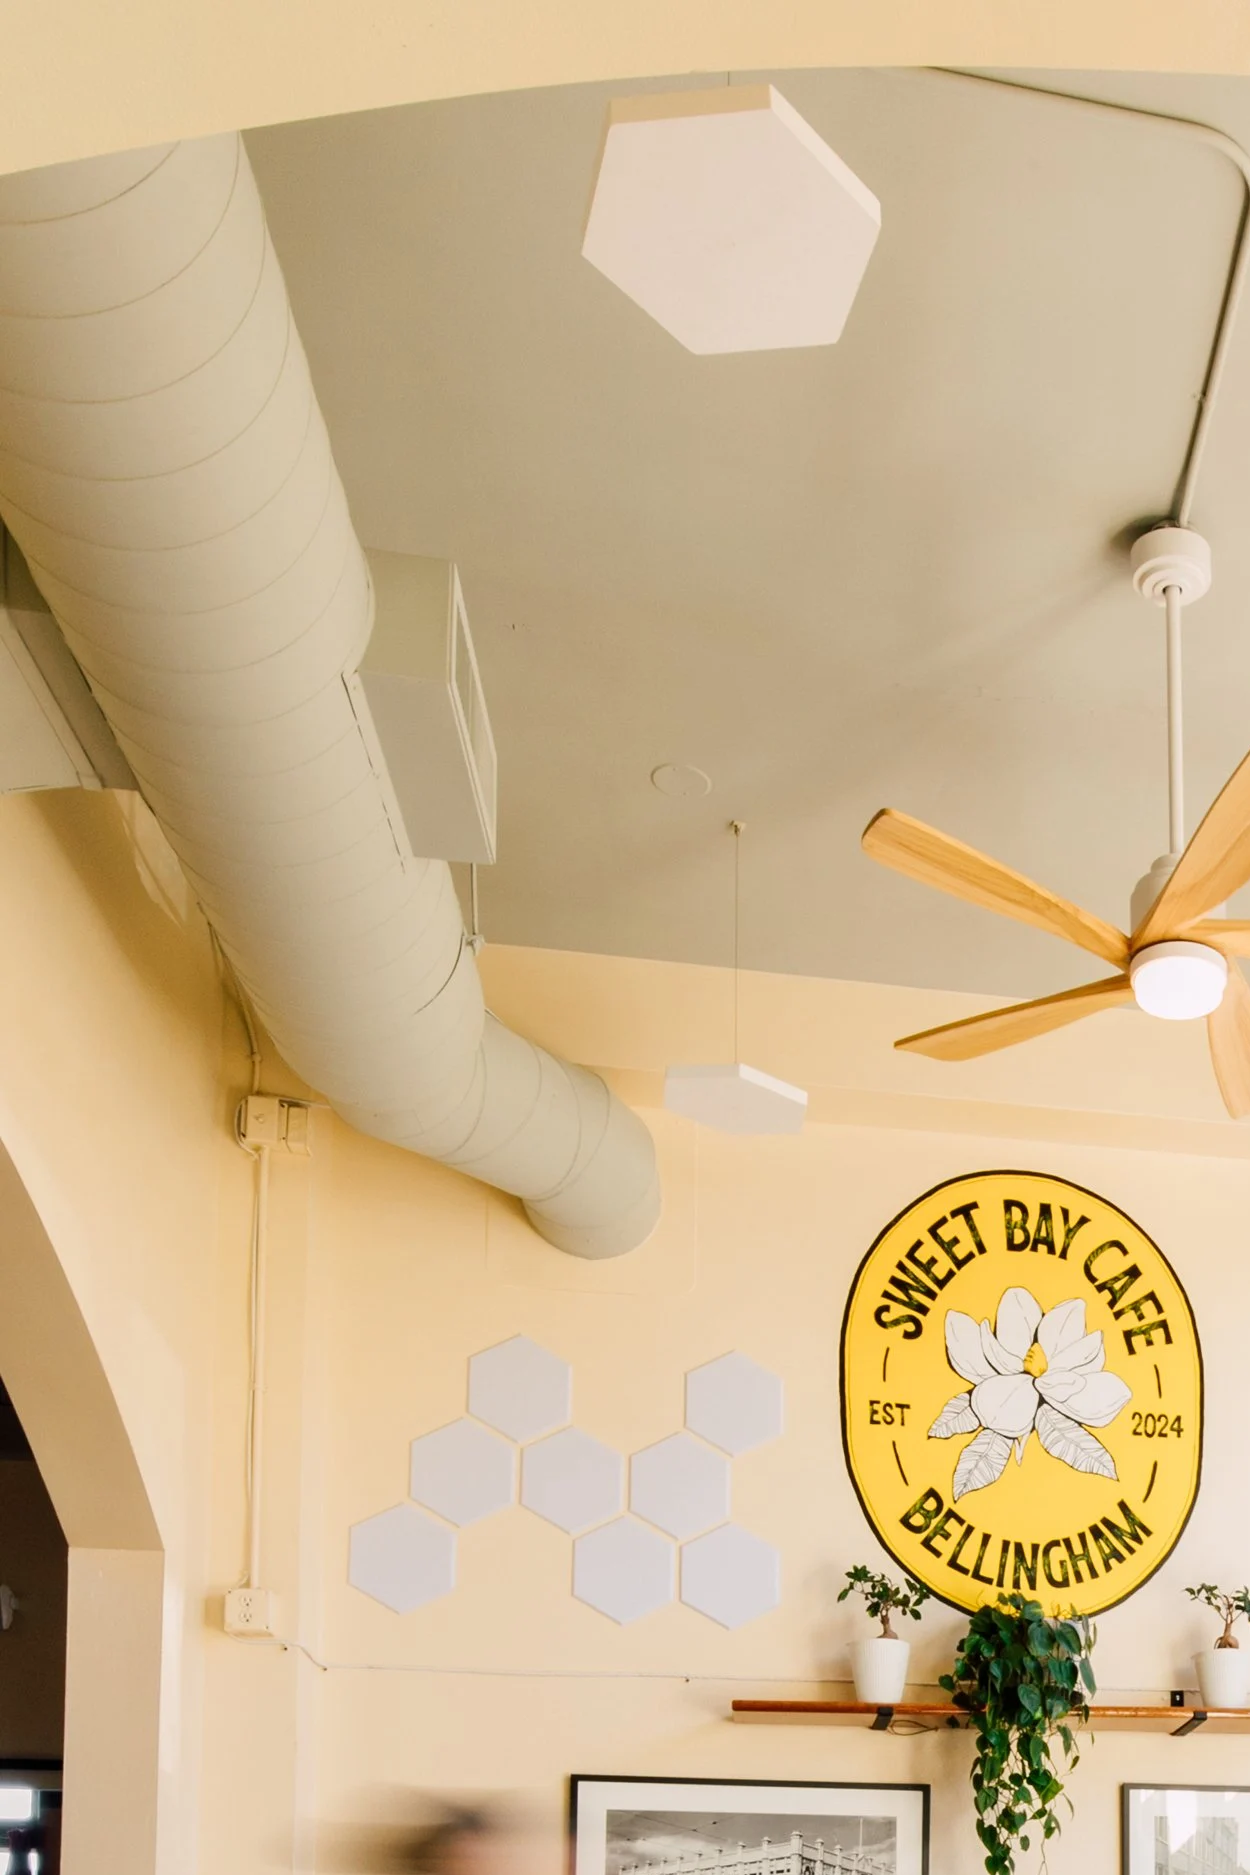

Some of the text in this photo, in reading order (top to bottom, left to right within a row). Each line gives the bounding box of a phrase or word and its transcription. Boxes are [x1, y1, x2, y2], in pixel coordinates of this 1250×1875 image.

[874, 1199, 1174, 1356] SWEET BAY CAFE
[869, 1400, 911, 1426] EST
[1131, 1412, 1184, 1439] 2024
[899, 1487, 1154, 1591] BELLINGHAM
